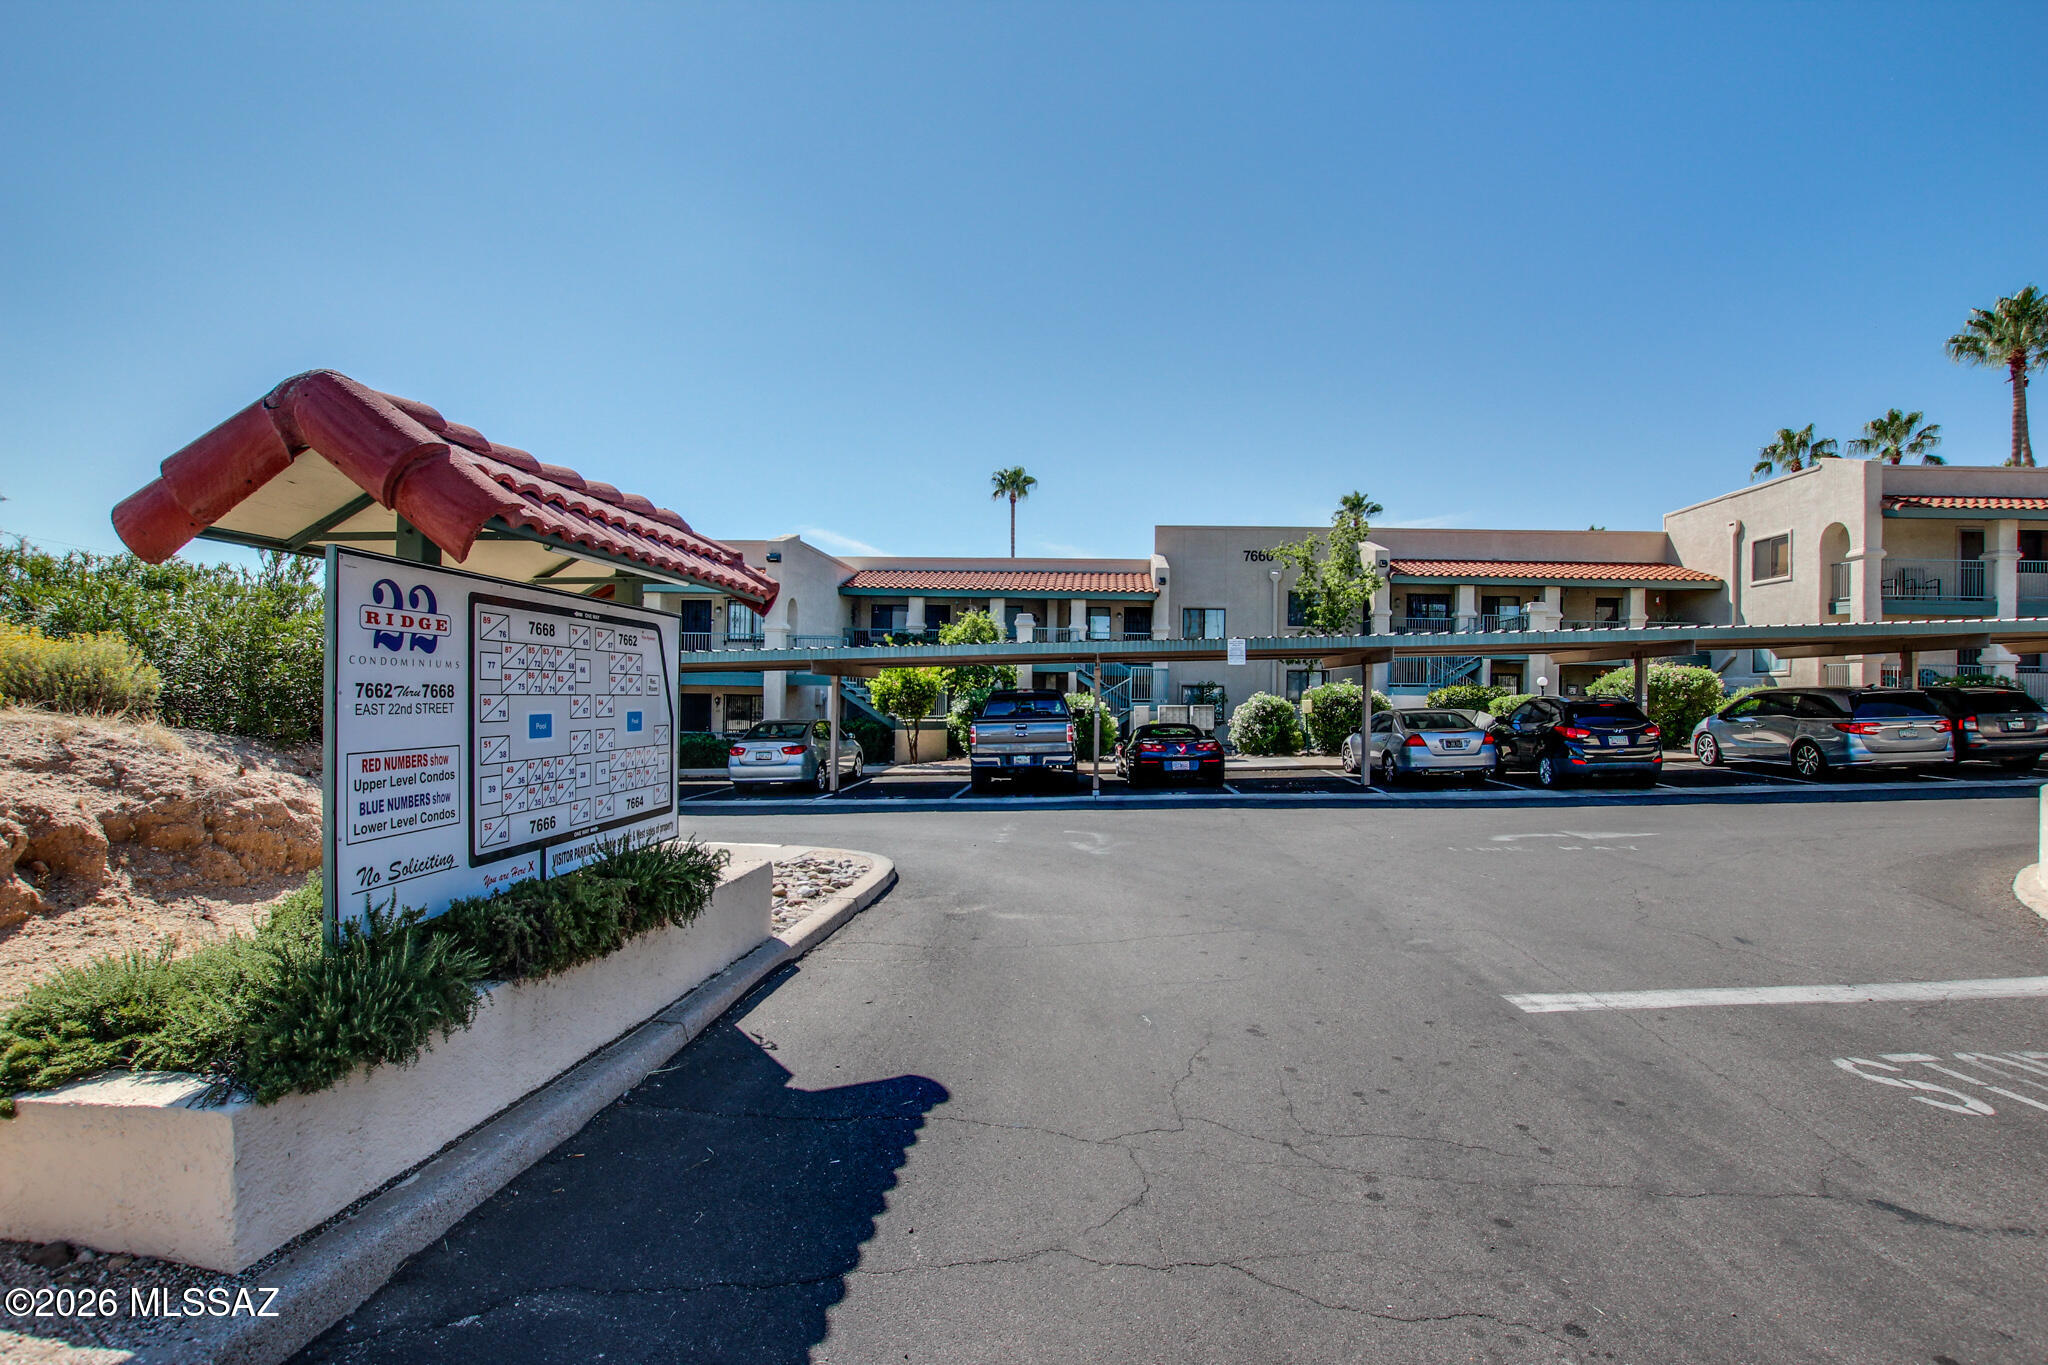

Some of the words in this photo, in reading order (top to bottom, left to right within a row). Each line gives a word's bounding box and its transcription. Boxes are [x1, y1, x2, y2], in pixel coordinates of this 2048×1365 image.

[365, 610, 448, 632] RIDGE
[372, 578, 438, 654] 22
[483, 616, 491, 624] 89
[529, 621, 555, 637] 7668
[618, 634, 638, 646] 7662
[349, 655, 460, 670] CONDOMINIUMS
[356, 682, 393, 698] 7662
[394, 685, 422, 698] Thru
[423, 684, 454, 698] 7668
[356, 704, 385, 716] EAST
[388, 704, 412, 714] 22nd
[416, 702, 454, 714] STREET
[362, 758, 381, 773] RED
[384, 754, 428, 771] NUMBERS
[430, 753, 450, 766] show
[354, 778, 388, 794] Upper
[390, 773, 416, 788] Level
[420, 770, 456, 784] Condos
[360, 800, 384, 816] BLUE
[388, 792, 431, 812] NUMBERS
[432, 792, 452, 805] show
[626, 796, 644, 810] 7664
[354, 820, 388, 836] Lower
[390, 814, 417, 829] Level
[420, 808, 456, 824] Condos
[530, 816, 556, 834] 7666
[552, 850, 574, 867] VISITOR
[574, 842, 596, 860] PARKING
[356, 866, 382, 887] No
[388, 853, 455, 881] Soliciting
[484, 874, 497, 888] You
[499, 872, 509, 880] are
[510, 866, 526, 877] Here
[528, 860, 534, 872] X
